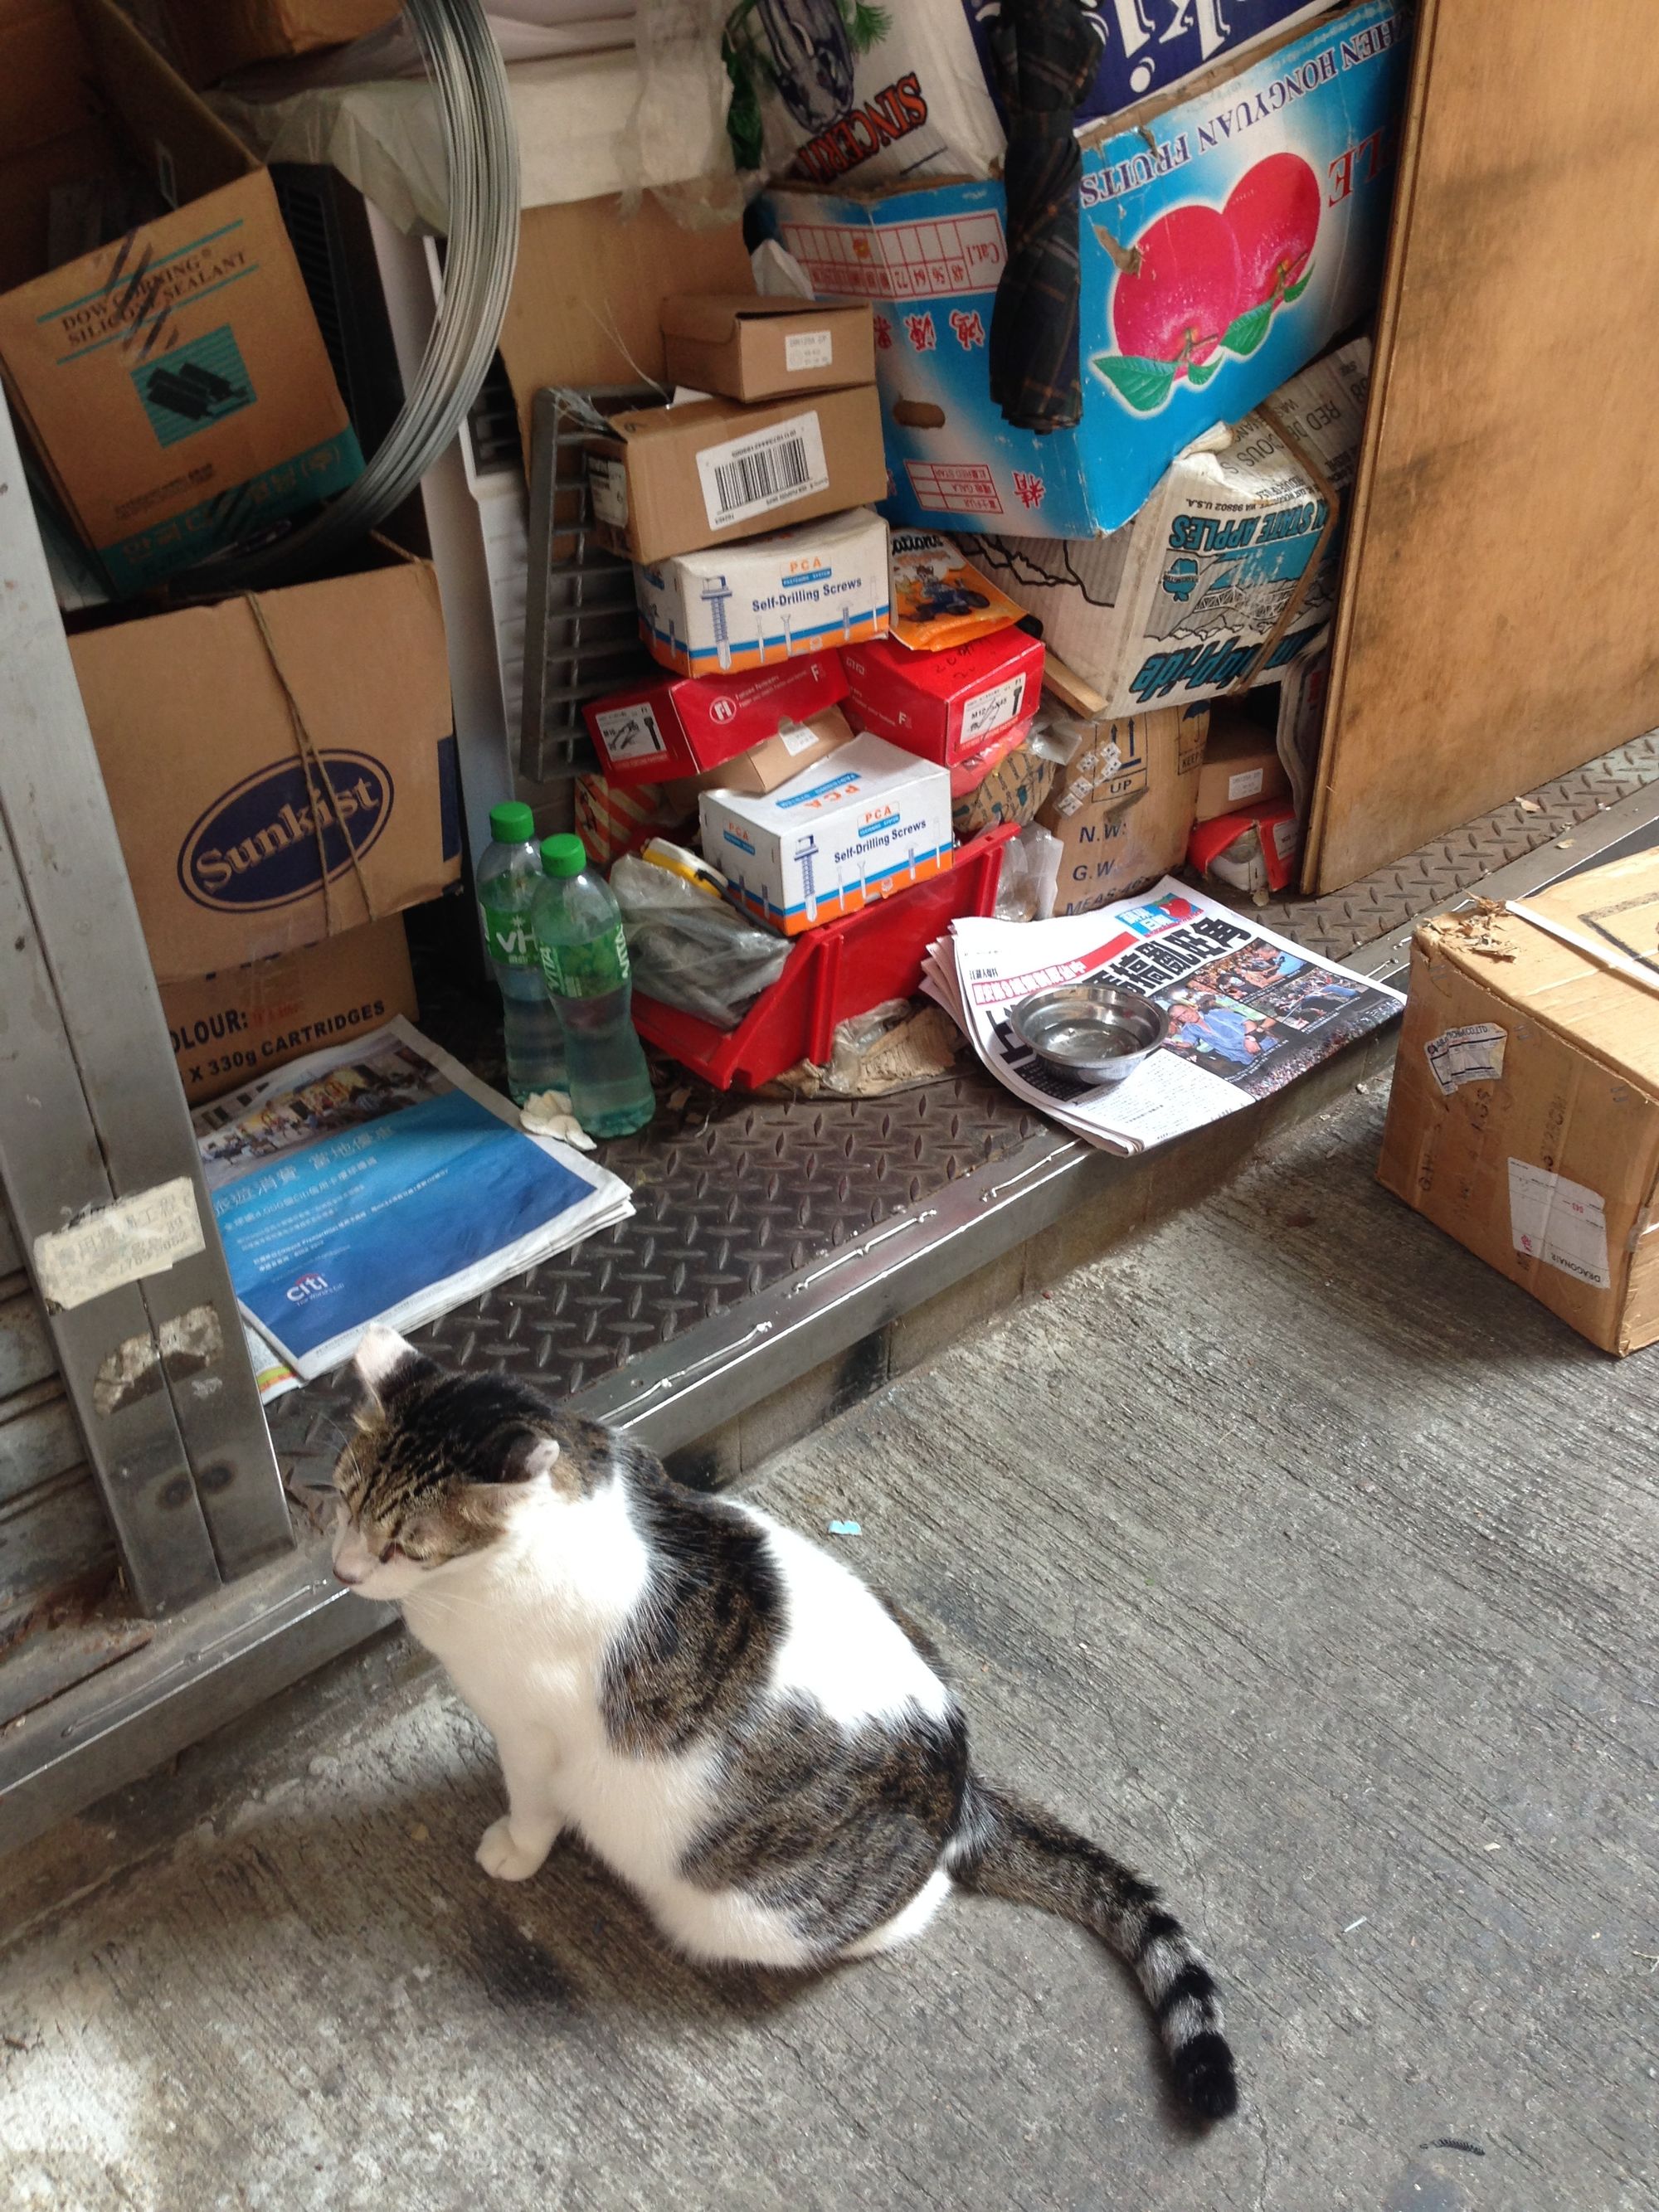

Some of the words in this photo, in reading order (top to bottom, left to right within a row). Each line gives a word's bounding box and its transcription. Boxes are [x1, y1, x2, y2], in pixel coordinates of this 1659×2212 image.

[1197, 48, 1335, 152] HONGYUAN
[1080, 137, 1190, 207] FRUITS
[165, 250, 247, 302] SEALANT
[61, 297, 109, 332] DOW
[1306, 401, 1340, 432] RED
[1237, 420, 1308, 467] DECIOUS
[1185, 498, 1213, 511] U.S.A.
[1170, 514, 1258, 549] APPLES
[1258, 503, 1314, 544] STATE
[788, 557, 823, 574] PCA
[752, 587, 820, 614] Self-Drilling
[823, 577, 863, 596] Screws
[803, 783, 860, 810] PCA
[1110, 778, 1132, 792] UP
[728, 821, 749, 840] PCA
[864, 805, 893, 824] PCA
[197, 775, 379, 892] Sunkist
[834, 829, 890, 864] Self-Drilling
[892, 818, 927, 841] Screws
[207, 1048, 258, 1076] 330g
[261, 1000, 386, 1056] CARTRIDGES
[1551, 1251, 1603, 1283] DRAGONAIR
[285, 1272, 328, 1304] citi
